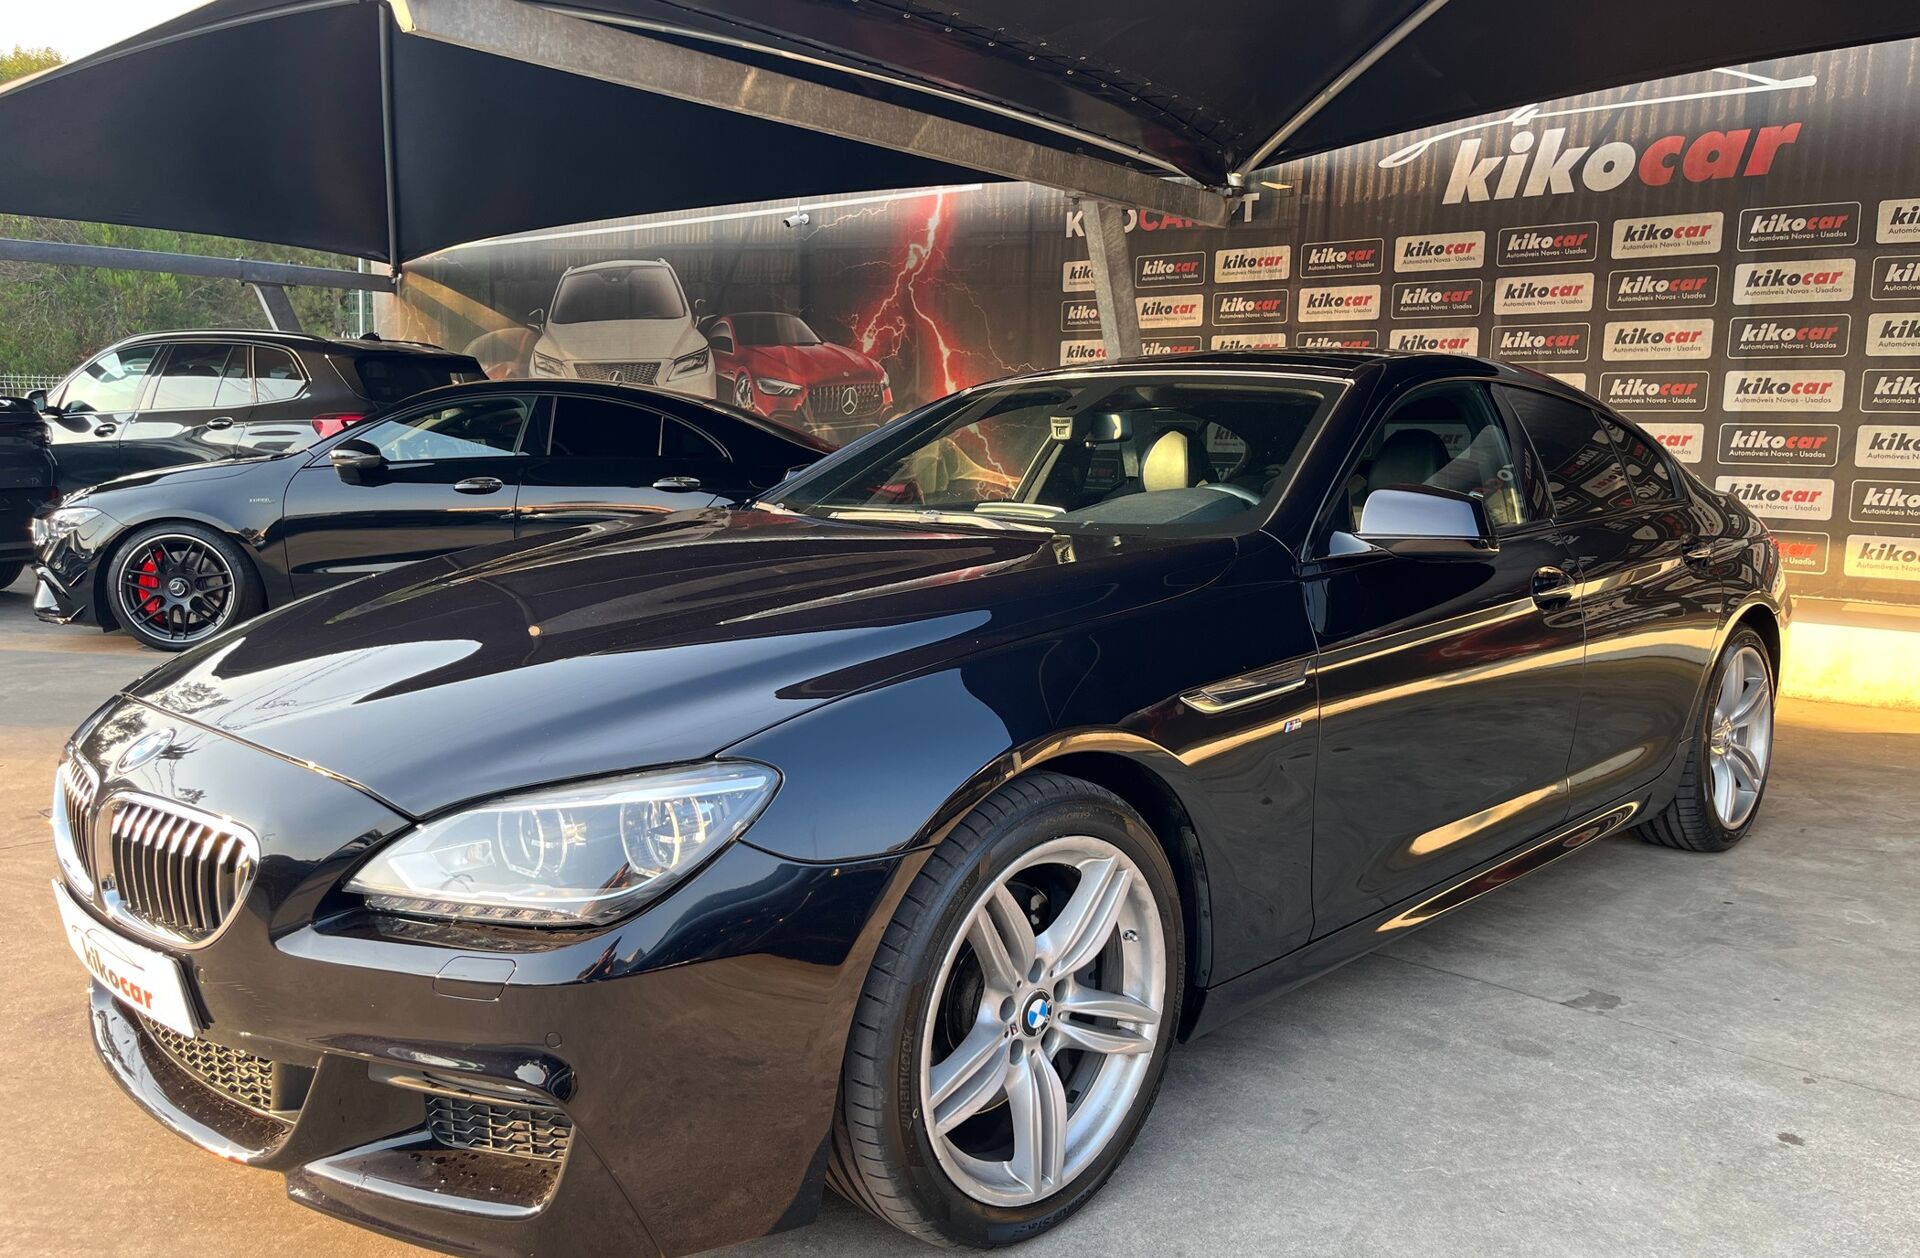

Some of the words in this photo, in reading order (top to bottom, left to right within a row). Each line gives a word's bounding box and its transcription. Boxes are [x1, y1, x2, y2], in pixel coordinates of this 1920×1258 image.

[1442, 122, 1802, 205] kikocar
[1750, 214, 1848, 234] kikocar
[1623, 224, 1712, 242] kikocar
[1749, 234, 1789, 243] Automóveis
[1791, 232, 1814, 241] Novos
[1820, 230, 1847, 238] Usados
[1403, 241, 1476, 257] kikocar
[1507, 233, 1588, 250] kikocar
[1621, 241, 1658, 250] Automóveis
[1660, 240, 1680, 248] Novos
[1308, 247, 1375, 264] kikocar
[1506, 250, 1540, 258] Automóveis
[1564, 247, 1587, 255] Usados
[1142, 260, 1198, 275] kikocar
[1222, 254, 1283, 270] kikocar
[1402, 257, 1432, 265] Automóveis
[1618, 276, 1708, 294] kikocar
[1745, 269, 1844, 287] kikocar
[1400, 288, 1473, 304] kikocar
[1504, 282, 1584, 299] kikocar
[1617, 294, 1654, 302] Automóveis
[1744, 288, 1785, 297] Automóveis
[1786, 286, 1809, 295] Novos
[1815, 285, 1842, 294] Usados
[1220, 297, 1281, 312] kikocar
[1306, 293, 1373, 308] kikocar
[1400, 304, 1430, 312] Automóveis
[1561, 297, 1583, 305] Usados
[1141, 301, 1197, 316] kikocar
[1500, 331, 1580, 348] kikocar
[1614, 328, 1702, 344] kikocar
[1740, 323, 1838, 342] kikocar
[1398, 335, 1470, 350] kikocar
[1676, 344, 1702, 352] Usados
[1738, 342, 1779, 350] Automóveis
[1780, 341, 1804, 349] Novos
[1810, 340, 1837, 349] Usados
[1499, 348, 1533, 356] Automóveis
[1609, 378, 1698, 396] kikocar
[1735, 377, 1833, 395] kikocar
[1734, 396, 1774, 404] Automóveis
[1775, 396, 1798, 404] Novos
[1804, 395, 1832, 403] Usados
[1872, 396, 1916, 404] Automóveis
[1730, 430, 1827, 449] kikocar
[1729, 449, 1769, 457] Automóveis
[1770, 450, 1793, 458] Novos
[1799, 450, 1826, 458] Usados
[1867, 452, 1910, 460] Automóveis
[1765, 503, 1788, 511] Novos
[1794, 504, 1821, 512] Usados
[1861, 507, 1905, 516] Automóveis
[1789, 557, 1816, 566] Usados
[81, 936, 153, 1010] kikocar
